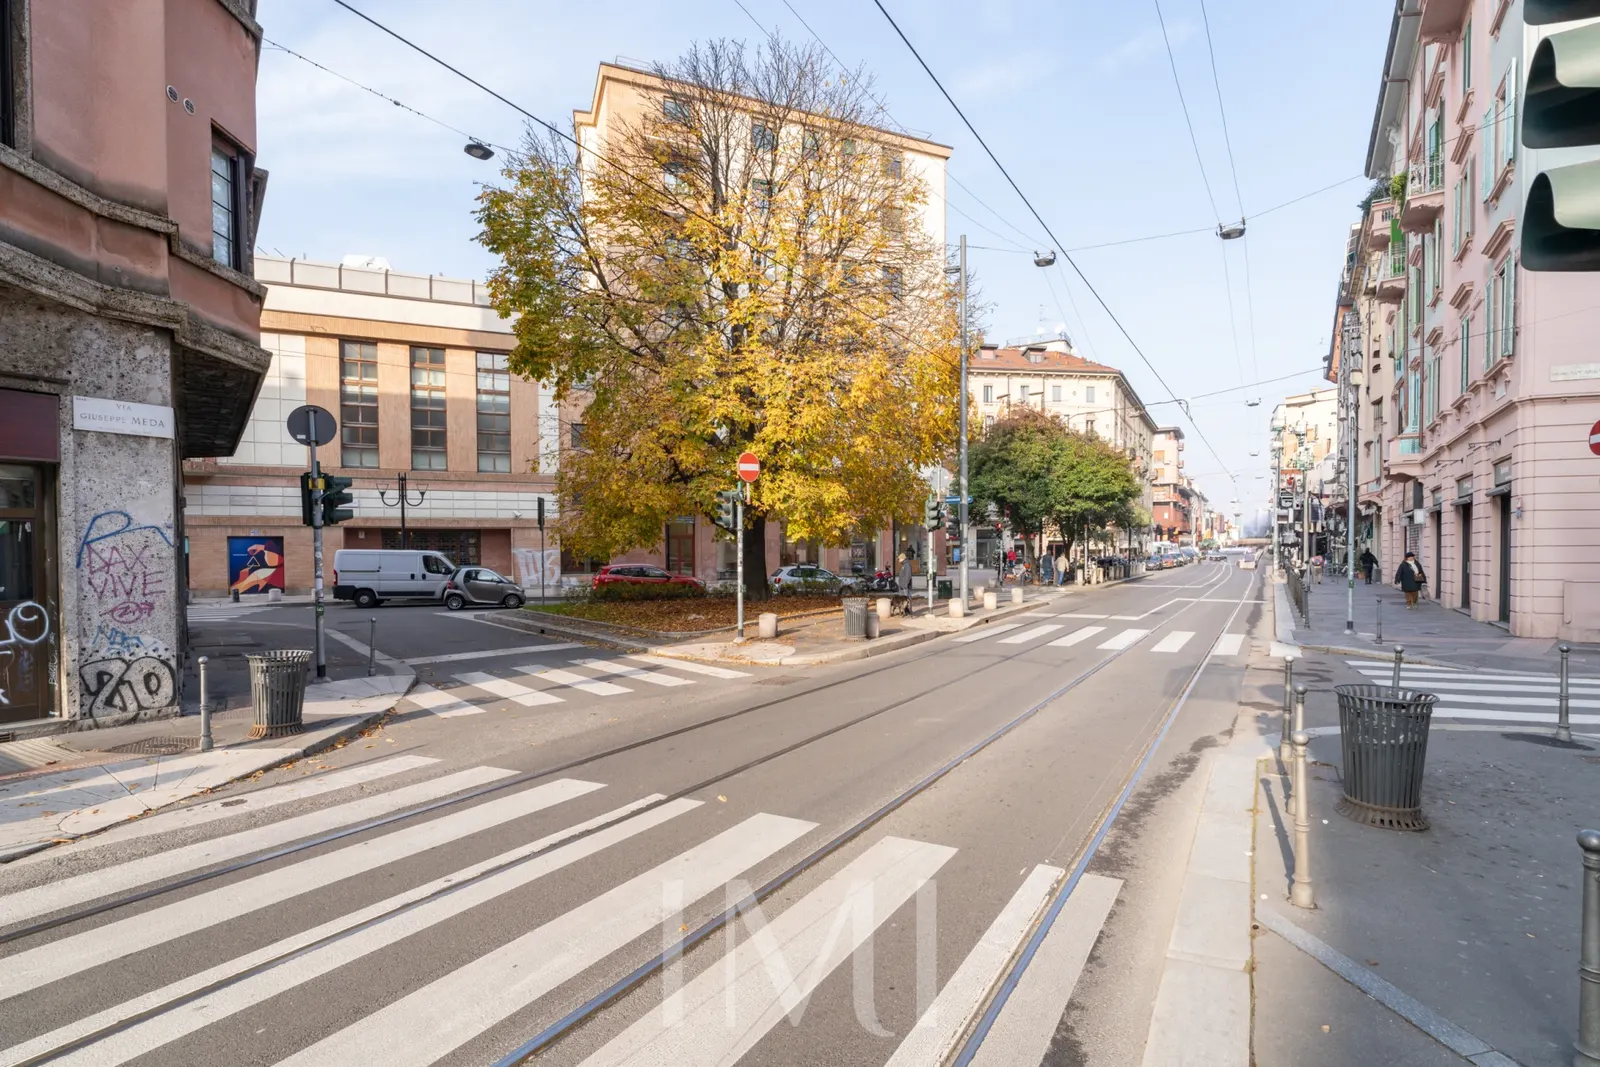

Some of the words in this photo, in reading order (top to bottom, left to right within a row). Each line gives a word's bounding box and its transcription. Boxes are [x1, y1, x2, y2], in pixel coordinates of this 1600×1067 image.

[116, 403, 132, 411] VIA
[79, 412, 127, 424] GIUSEPPE
[131, 416, 166, 428] MEDA
